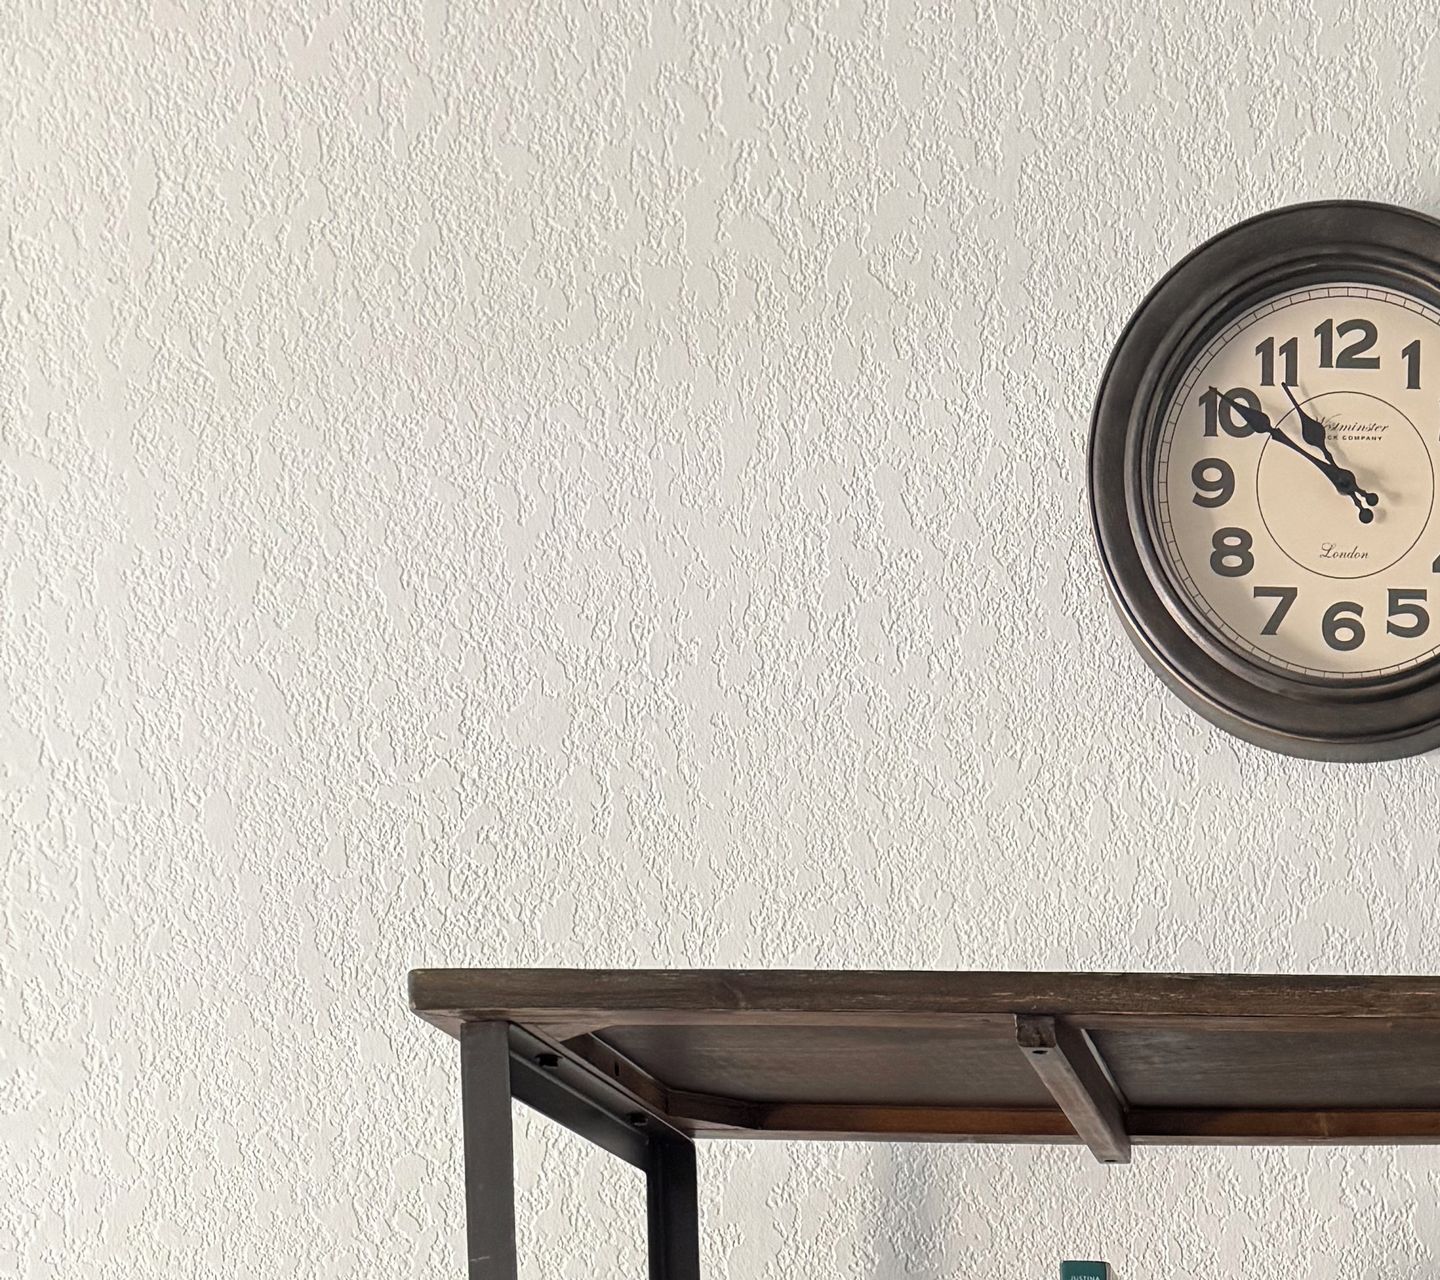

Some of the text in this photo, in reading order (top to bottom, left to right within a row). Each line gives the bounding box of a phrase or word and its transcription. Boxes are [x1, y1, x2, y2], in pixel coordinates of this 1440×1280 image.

[1255, 336, 1299, 387] 11
[1314, 318, 1380, 369] 12
[1401, 339, 1421, 390] 1
[1199, 387, 1262, 438] 10
[1191, 457, 1235, 508] 9
[1209, 527, 1254, 577] 8
[1319, 542, 1368, 559] London
[1253, 587, 1298, 635] 7
[1321, 602, 1365, 652] 6
[1386, 588, 1430, 638] 5
